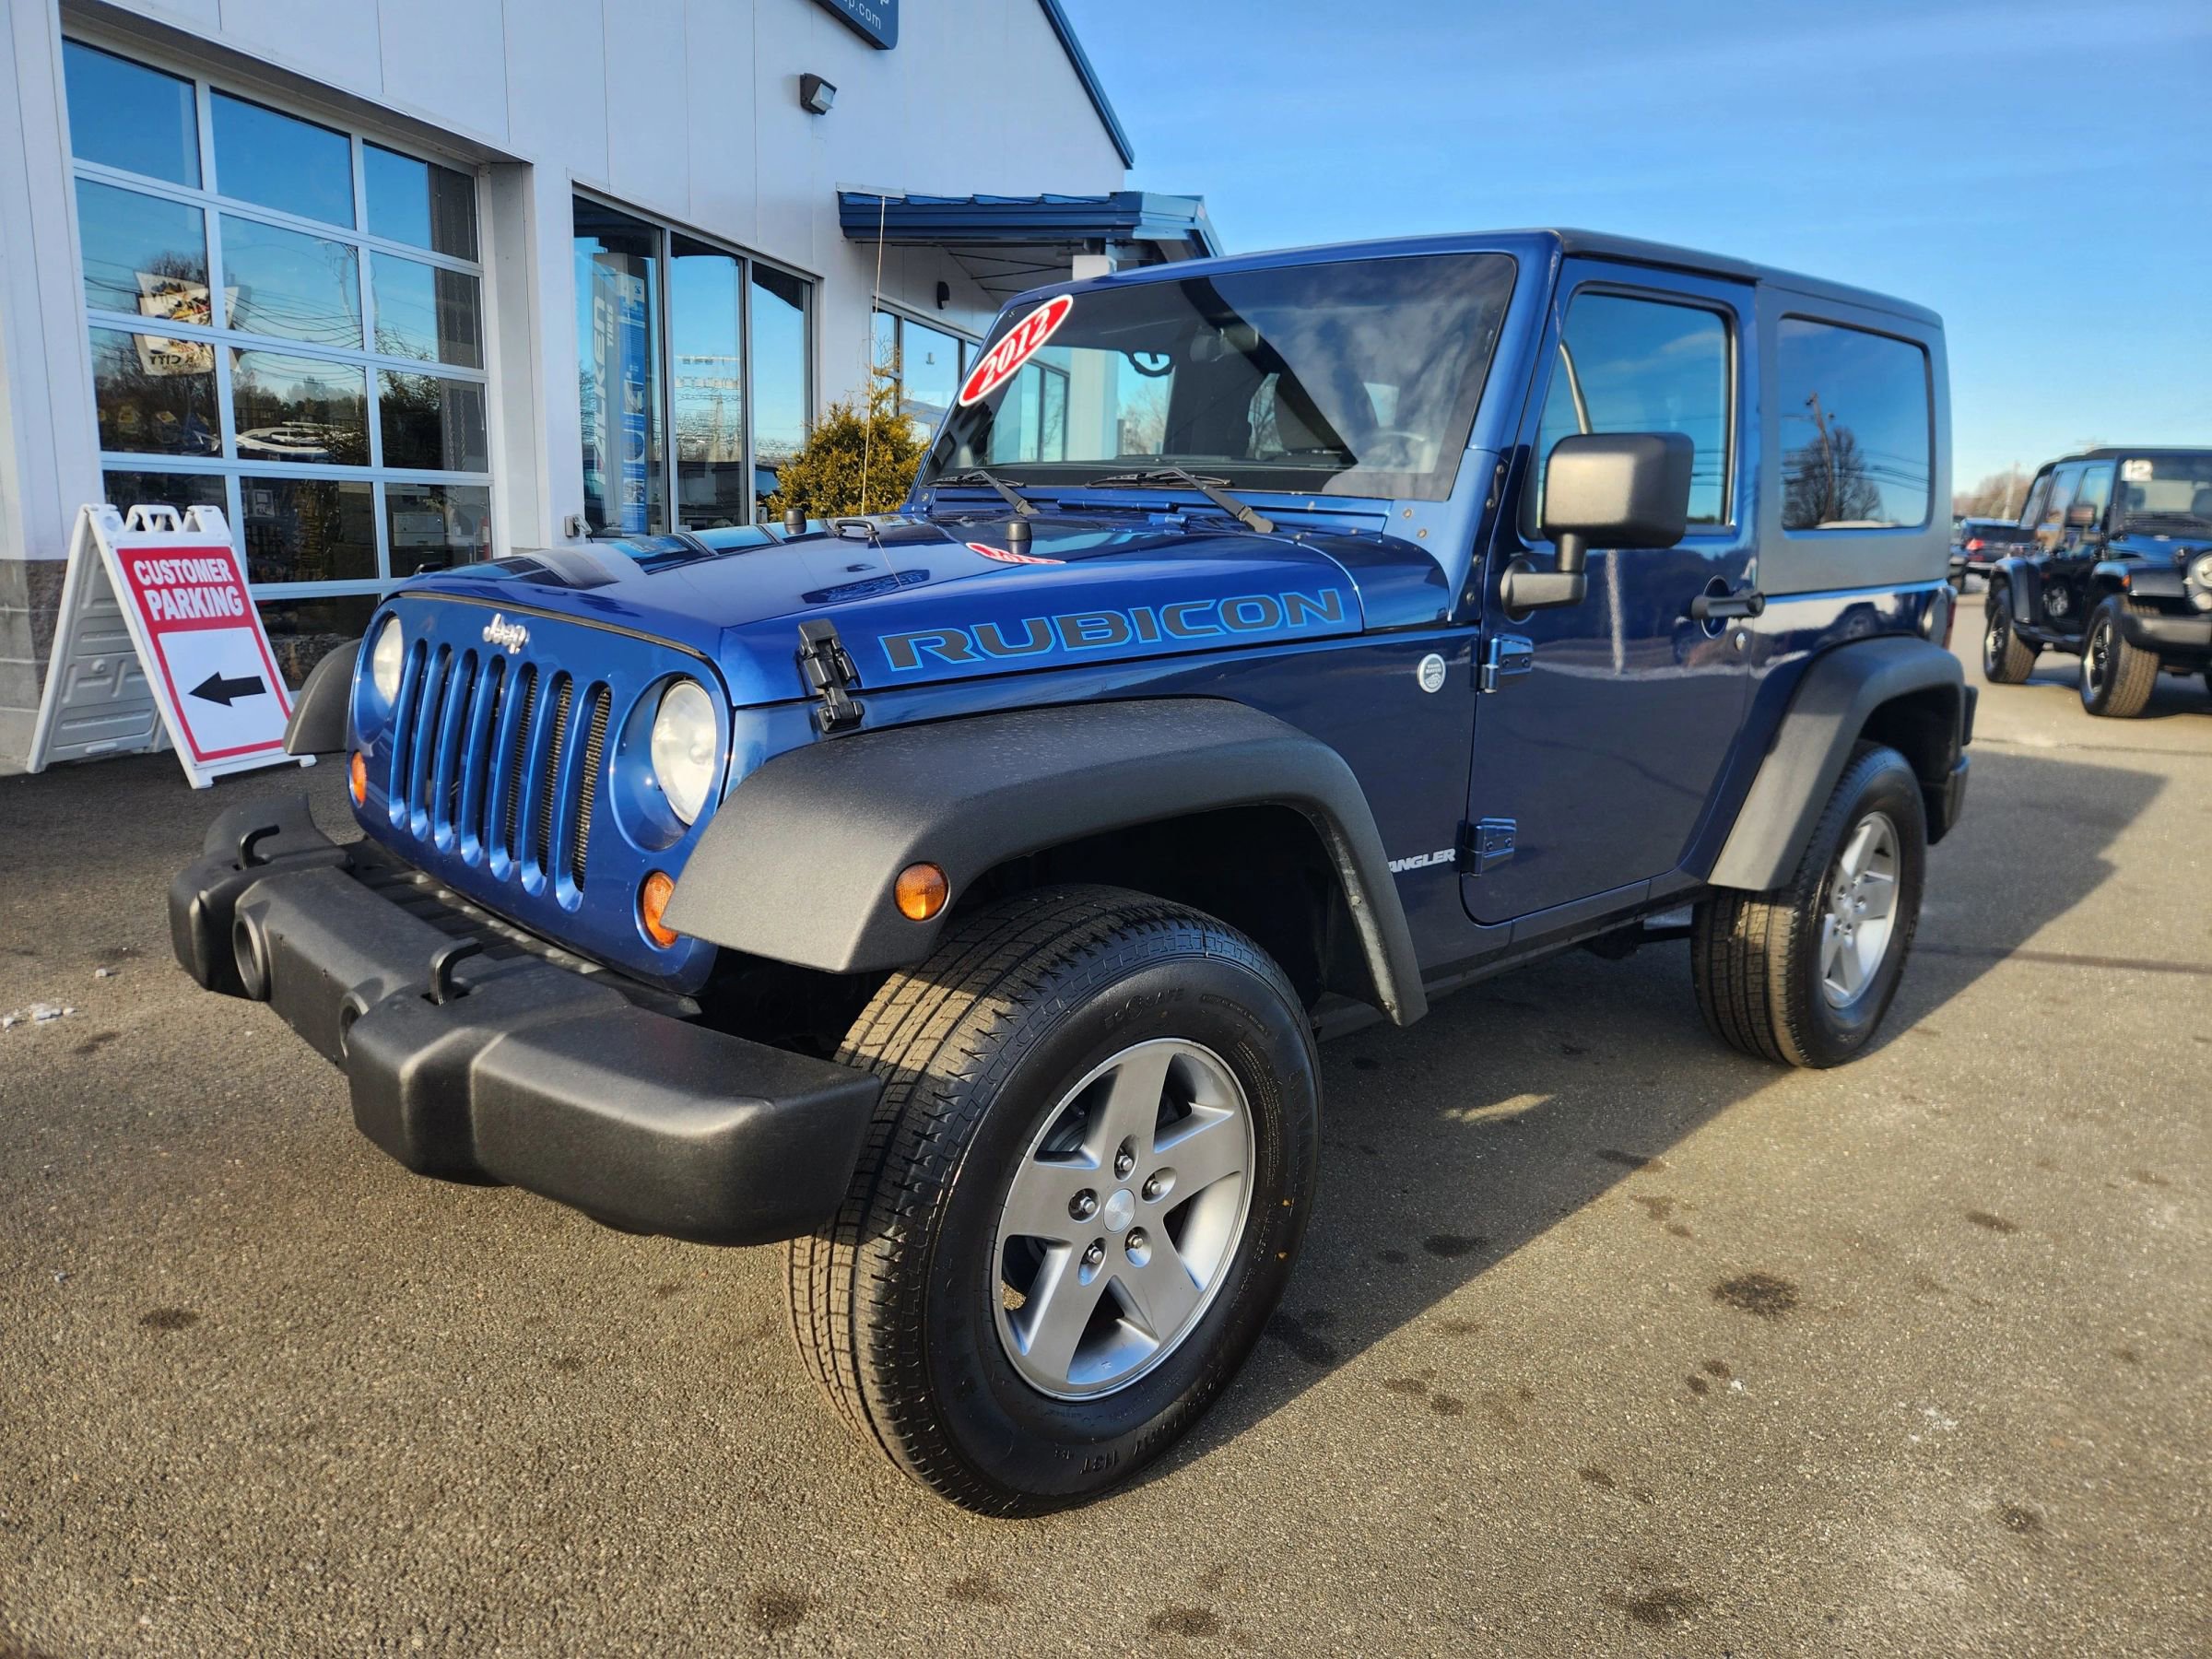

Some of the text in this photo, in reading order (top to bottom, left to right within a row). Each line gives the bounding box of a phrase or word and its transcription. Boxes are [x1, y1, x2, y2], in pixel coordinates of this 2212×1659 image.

[843, 0, 882, 29] p.com
[606, 304, 615, 347] TIRES
[978, 308, 1051, 394] 2012
[133, 559, 235, 586] CUSTOMER
[143, 585, 245, 622] PARKING
[877, 587, 1346, 672] RUBICON
[1387, 848, 1456, 874] ANGLER
